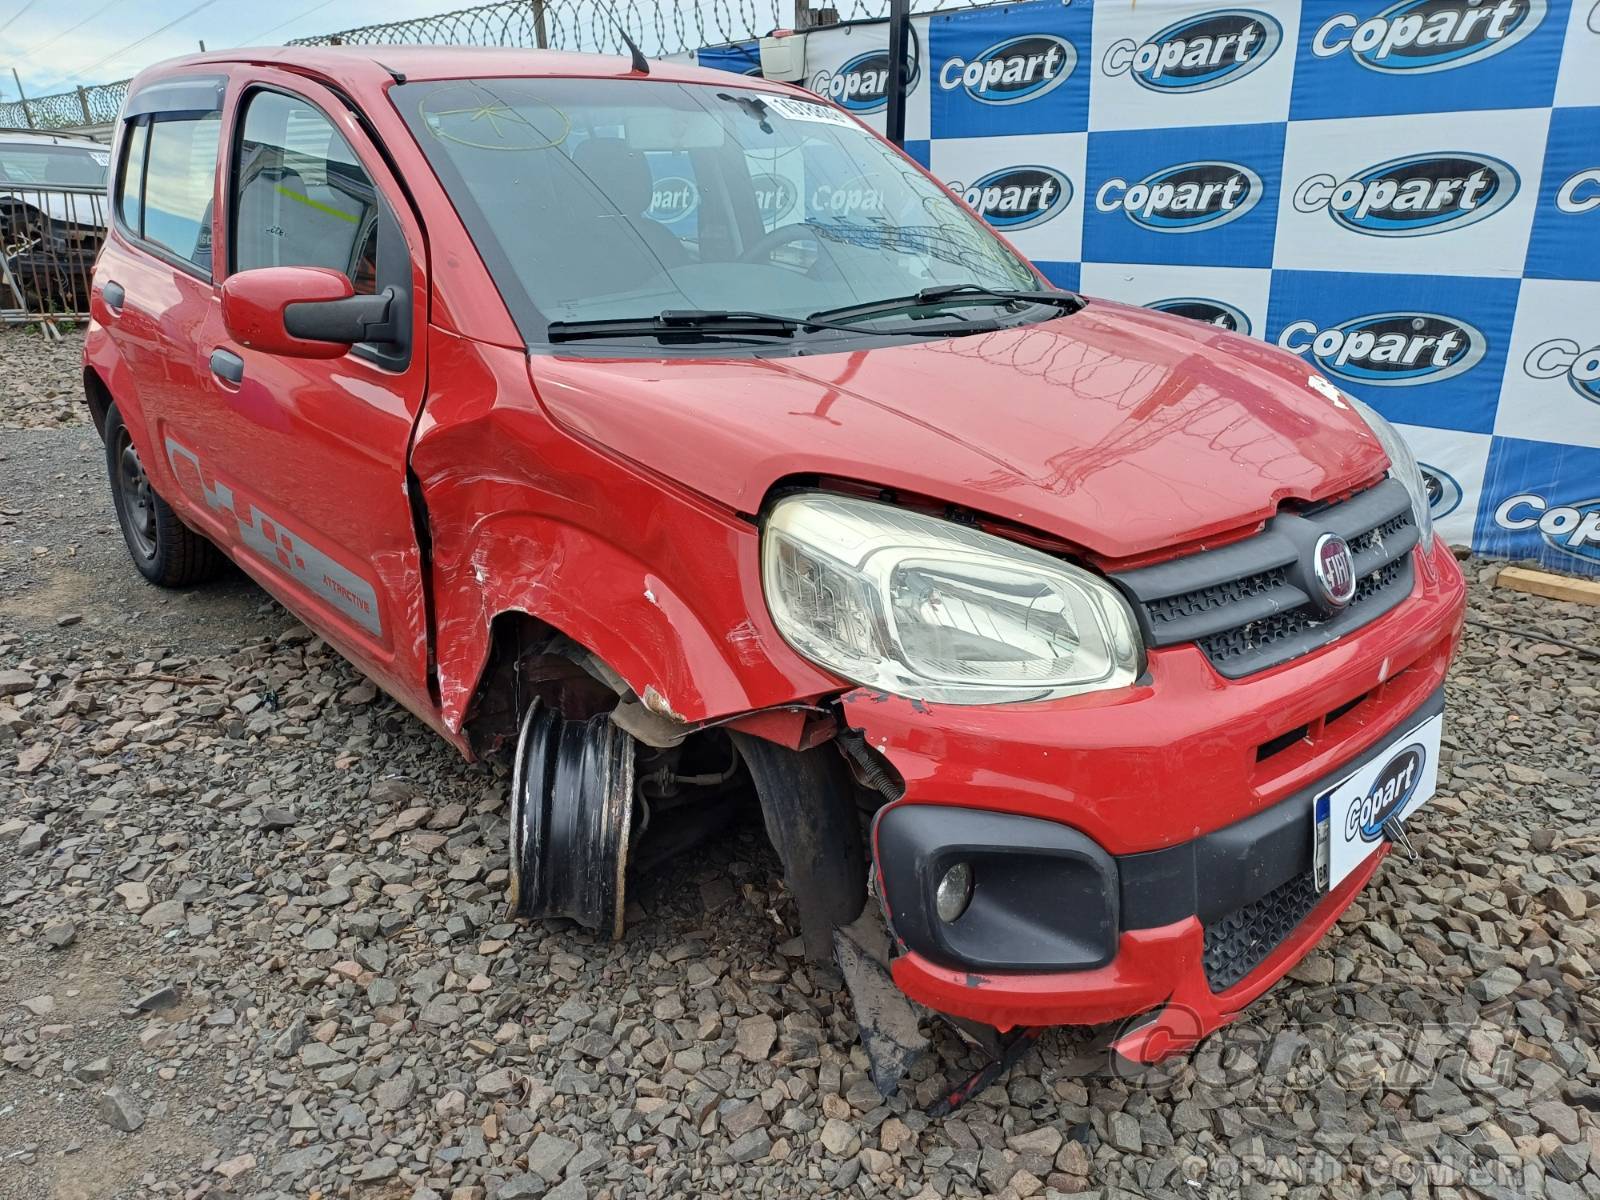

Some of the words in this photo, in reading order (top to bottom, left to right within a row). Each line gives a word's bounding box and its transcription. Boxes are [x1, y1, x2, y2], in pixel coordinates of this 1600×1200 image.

[1102, 23, 1260, 80] Copart
[1312, 0, 1520, 60] Copart
[811, 69, 889, 102] Copar
[939, 46, 1062, 91] Copart
[650, 186, 690, 212] part
[1096, 173, 1246, 218] Copart
[1293, 169, 1490, 219] Copart
[1279, 319, 1463, 368] Copart
[1494, 493, 1600, 547] Cop
[1325, 551, 1350, 588] FIAT
[322, 573, 370, 614] ATTRACTIVE
[1344, 759, 1417, 842] Copart
